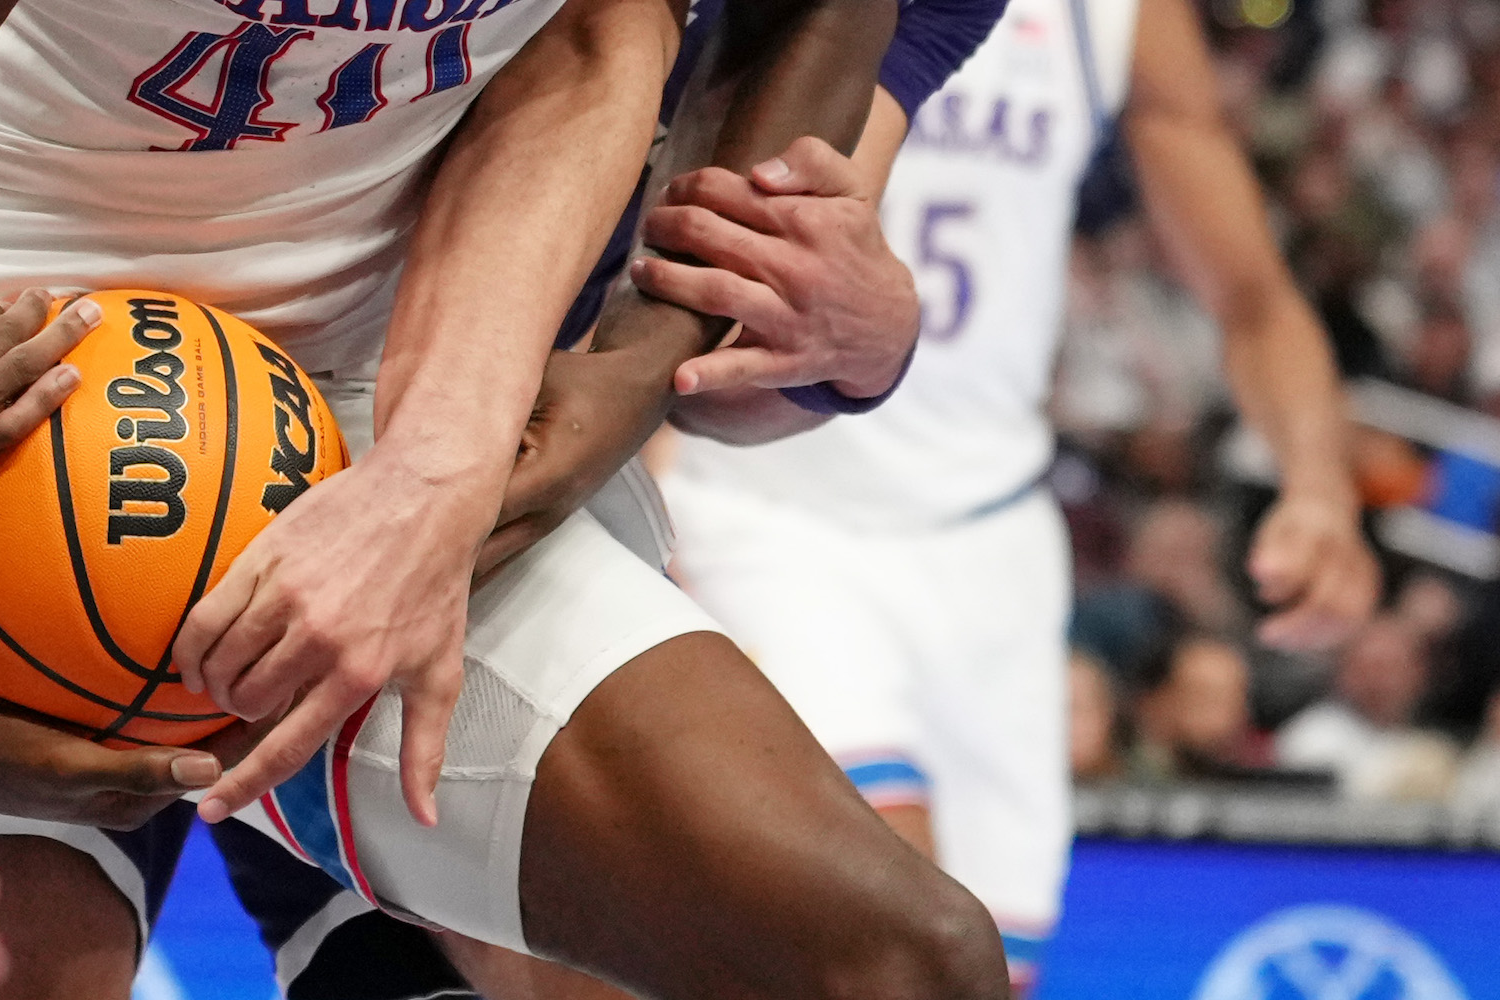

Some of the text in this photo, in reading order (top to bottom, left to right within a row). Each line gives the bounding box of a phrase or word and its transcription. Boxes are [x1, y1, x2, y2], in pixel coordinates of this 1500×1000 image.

[916, 202, 978, 342] 5
[106, 297, 189, 546] Wilson
[194, 338, 207, 455] INDOOR GAME BALL
[253, 340, 316, 515] NCAA
